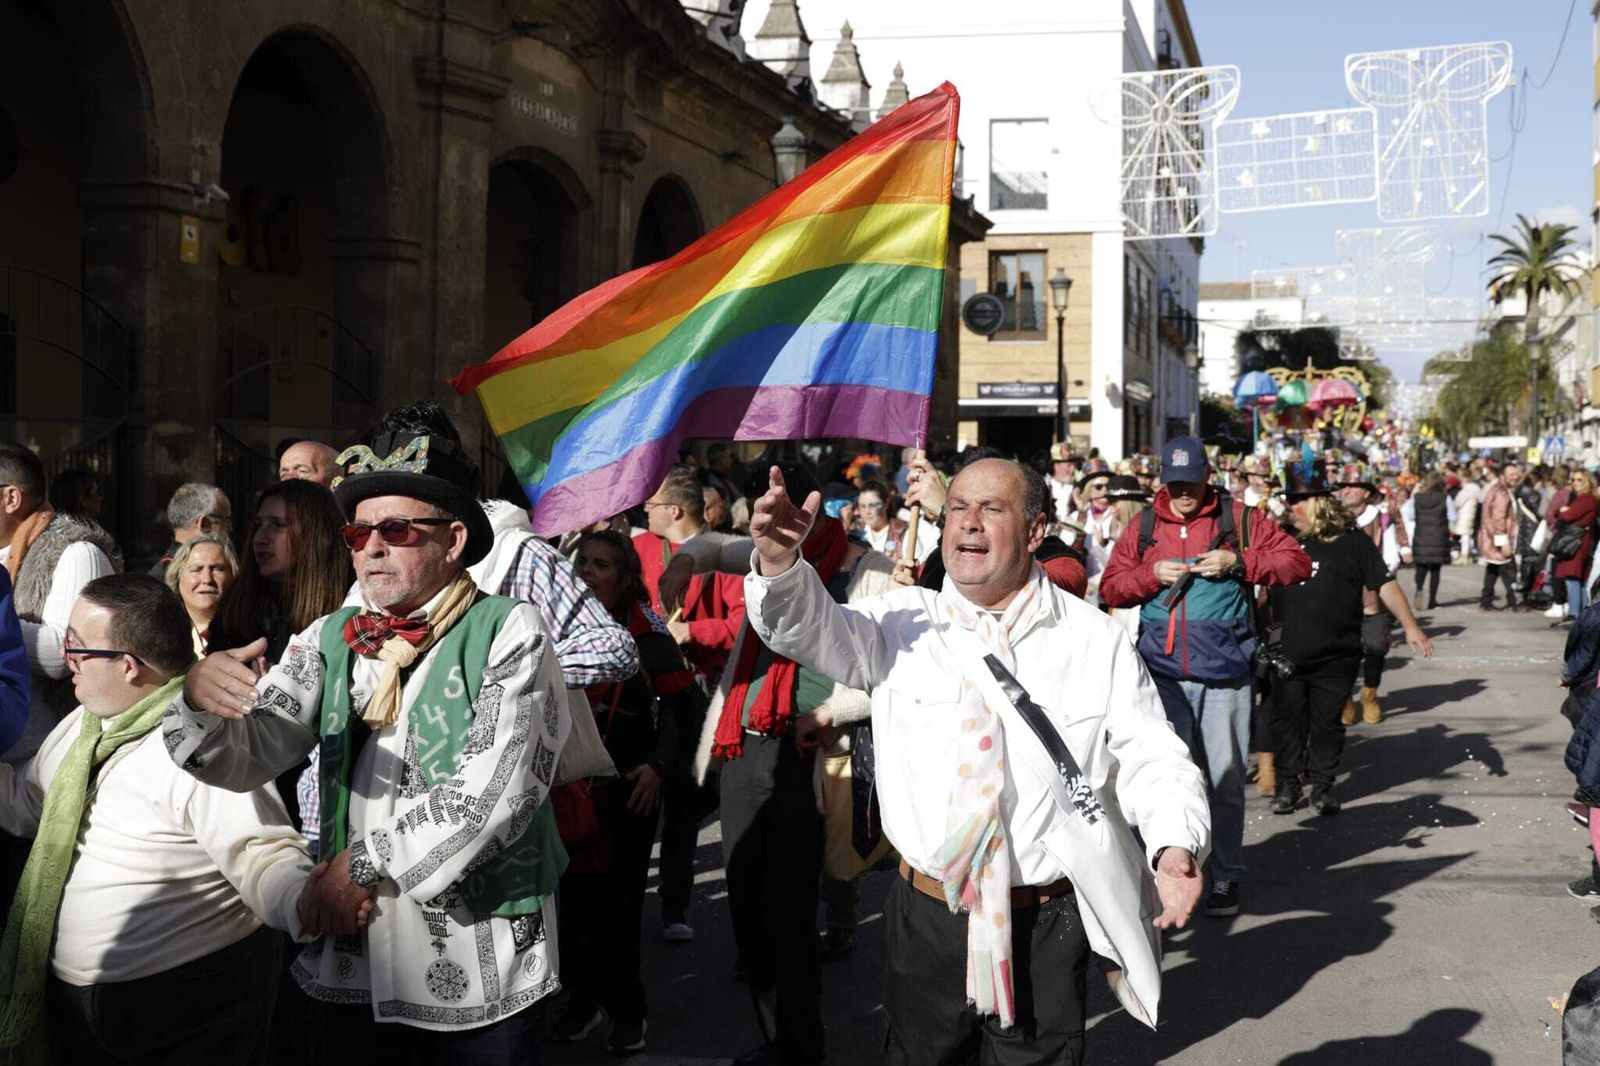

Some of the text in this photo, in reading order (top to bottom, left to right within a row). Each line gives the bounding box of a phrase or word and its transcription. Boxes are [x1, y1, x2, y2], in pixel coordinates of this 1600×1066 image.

[333, 677, 342, 707] 1
[443, 665, 465, 699] 5
[327, 711, 340, 735] 2
[422, 703, 450, 736] 4
[428, 759, 451, 783] 5
